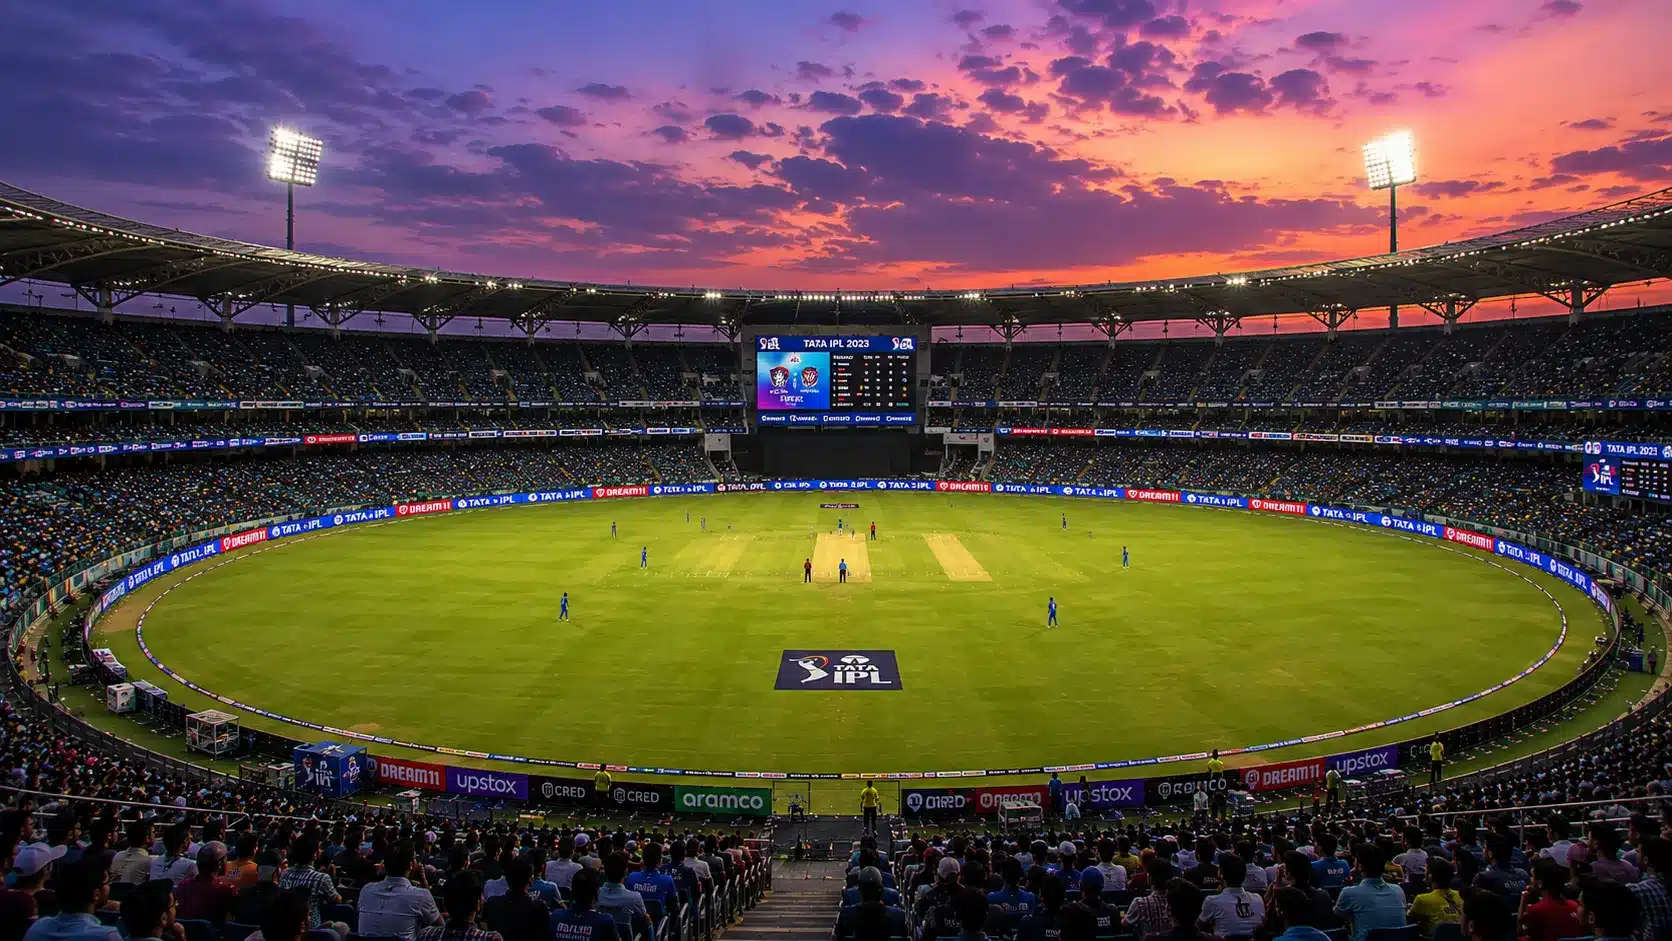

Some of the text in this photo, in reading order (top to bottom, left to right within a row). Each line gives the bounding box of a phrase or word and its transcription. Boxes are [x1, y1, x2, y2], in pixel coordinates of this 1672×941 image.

[804, 339, 870, 348] TATA IPL 2023
[1607, 444, 1626, 453] TATA
[1640, 446, 1658, 456] 2023
[916, 482, 932, 490] IPL
[1036, 486, 1052, 494] IPL
[1075, 487, 1119, 498] TATA IPL
[469, 495, 516, 508] TATA IPL
[539, 490, 586, 501] TATA IPL
[1199, 495, 1243, 507] TATA IPL
[344, 509, 390, 523] TATA IPL
[1322, 508, 1369, 523] TATA IPL
[281, 519, 323, 535] TATA IPL
[1392, 518, 1438, 536] TATA IPL
[833, 670, 892, 684] IPL
[1336, 751, 1388, 775] upstox
[380, 763, 440, 786] DREAM11
[1262, 764, 1320, 786] DREAM11
[456, 774, 517, 795] upstox
[555, 785, 586, 799] CRED
[627, 790, 660, 804] CRED
[682, 792, 764, 810] aramco
